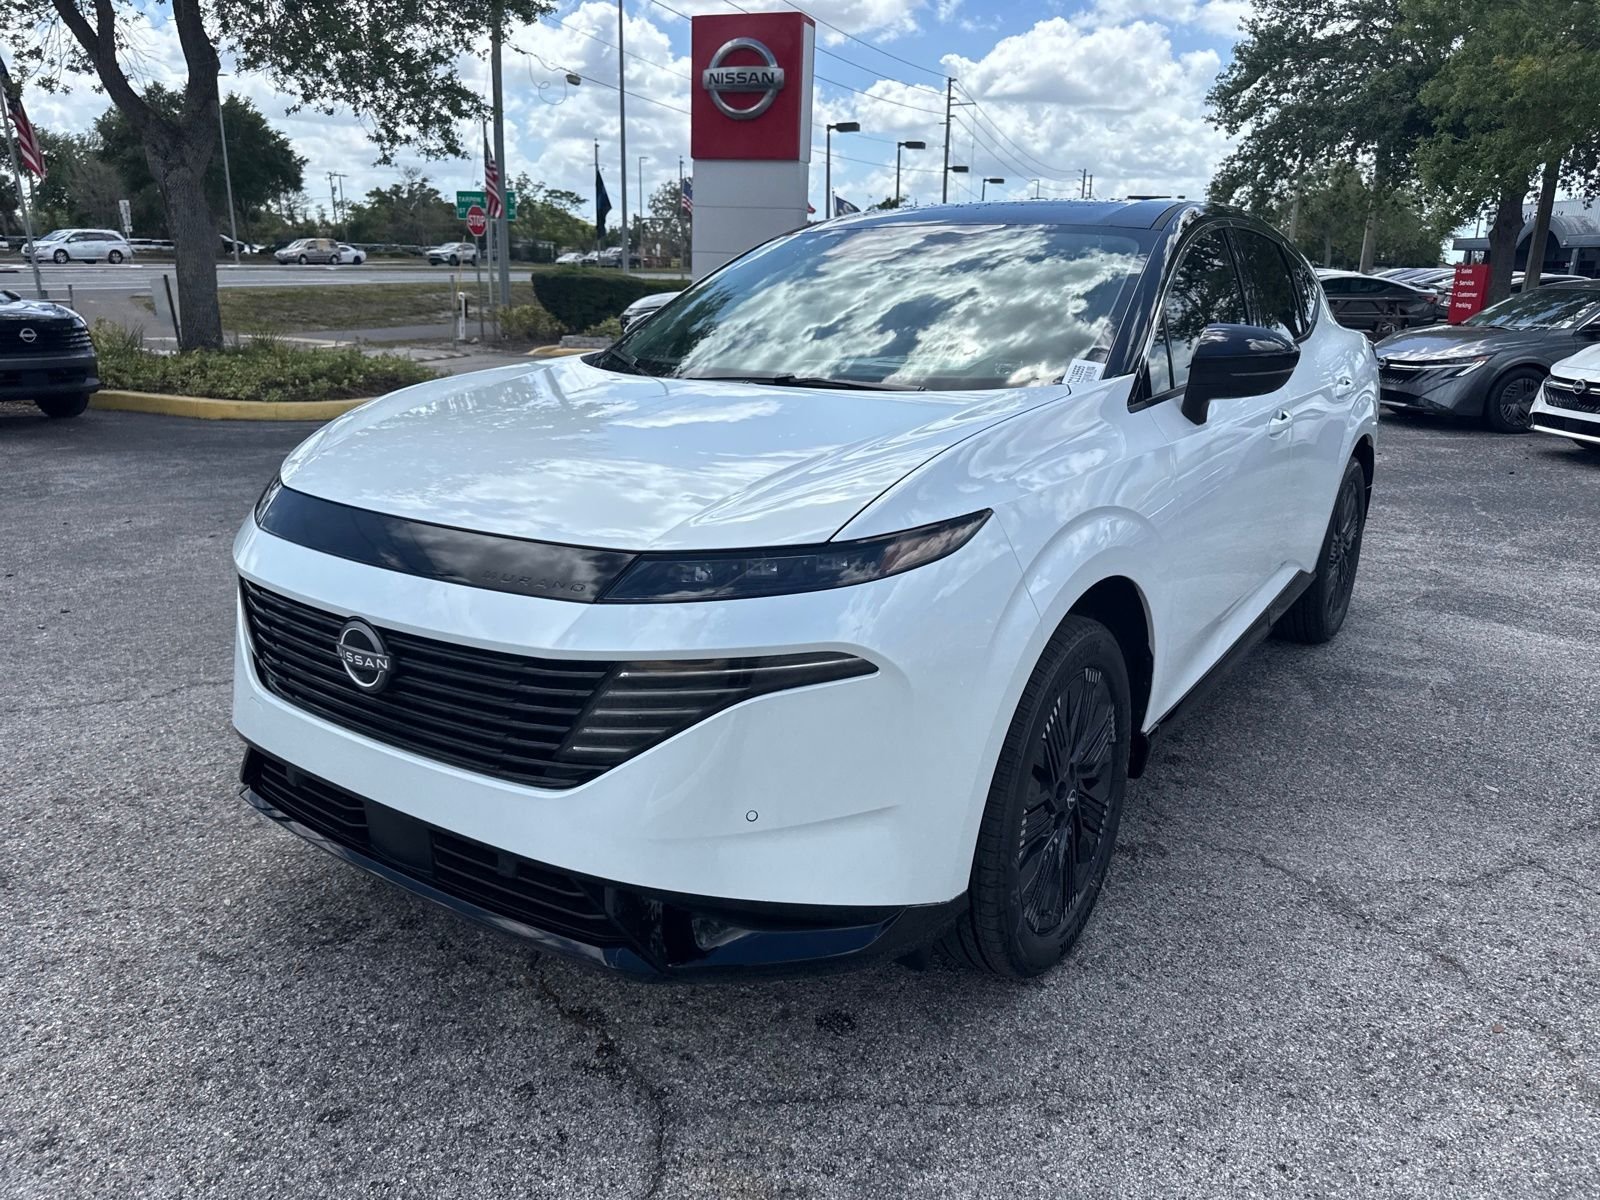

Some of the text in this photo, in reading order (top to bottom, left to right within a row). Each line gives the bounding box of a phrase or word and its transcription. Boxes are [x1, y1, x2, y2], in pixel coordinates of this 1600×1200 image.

[708, 72, 775, 85] NISSAN
[468, 215, 486, 227] STOP
[1455, 302, 1472, 310] Parking
[481, 570, 586, 592] MURANO
